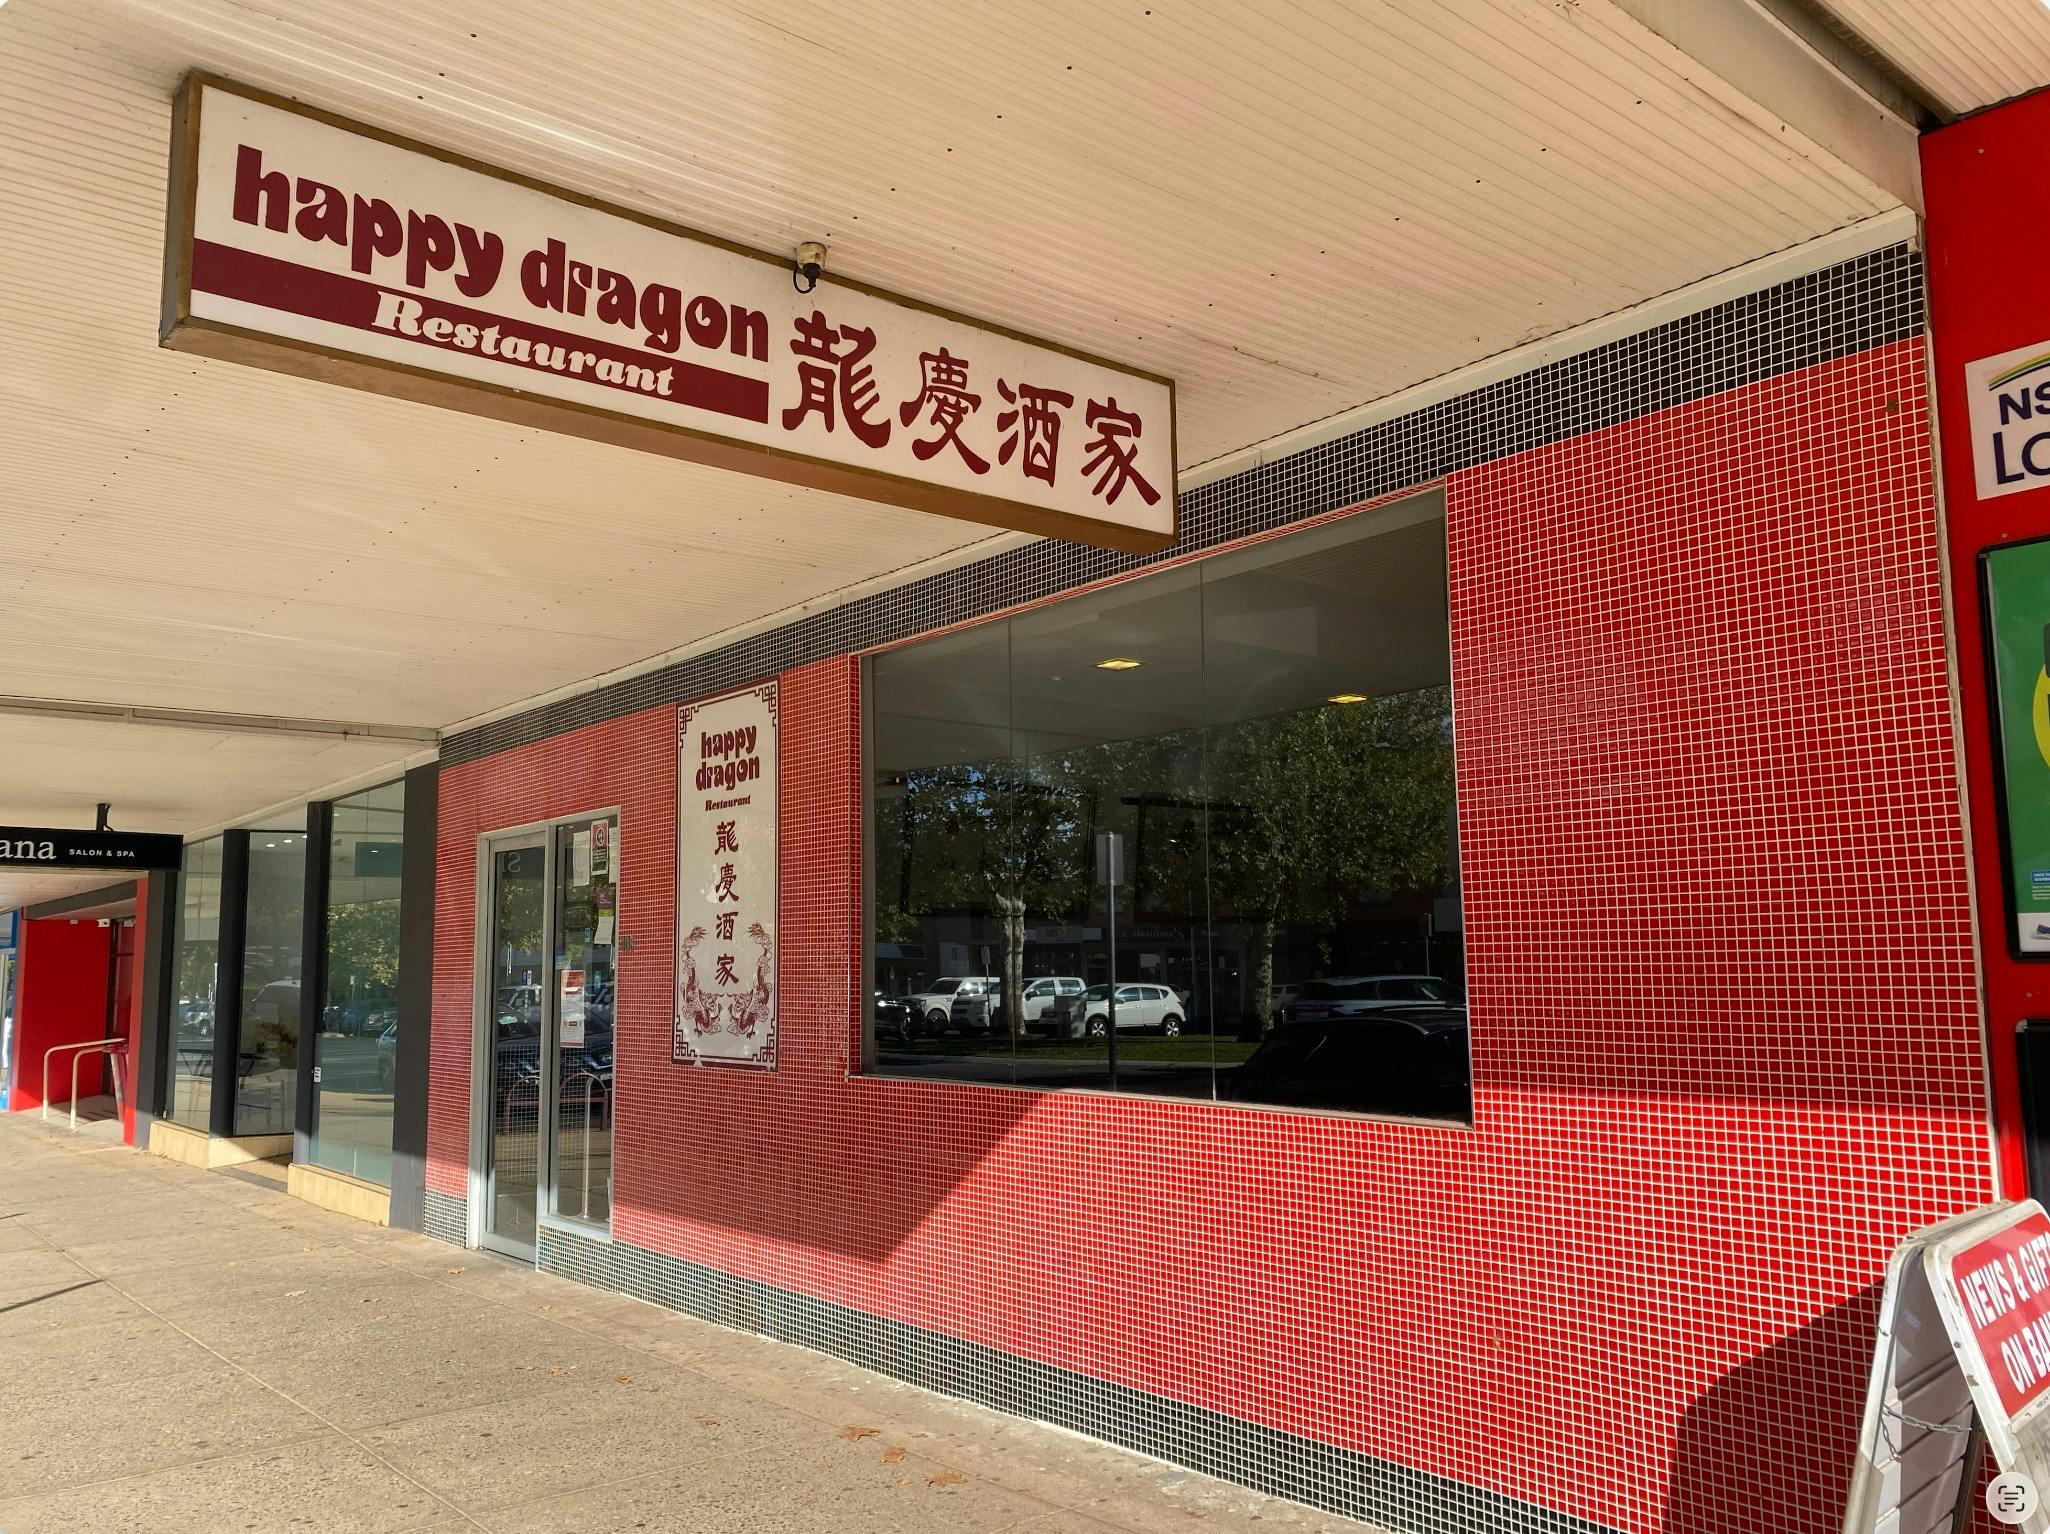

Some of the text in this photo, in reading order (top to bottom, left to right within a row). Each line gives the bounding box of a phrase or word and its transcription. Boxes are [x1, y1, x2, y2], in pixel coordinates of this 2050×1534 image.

[232, 143, 770, 363] happy dragon
[371, 290, 674, 396] Restaurant
[781, 309, 1162, 506] 龍慶酒家
[695, 755, 760, 792] dragon
[701, 725, 757, 762] happy
[704, 794, 752, 812] Restaurant
[68, 848, 102, 856] SALON
[116, 850, 135, 858] SPA
[713, 819, 740, 987] 龍慶酒家
[1960, 1231, 2050, 1330] NEWS & GIFT
[2001, 1333, 2037, 1395] ON
